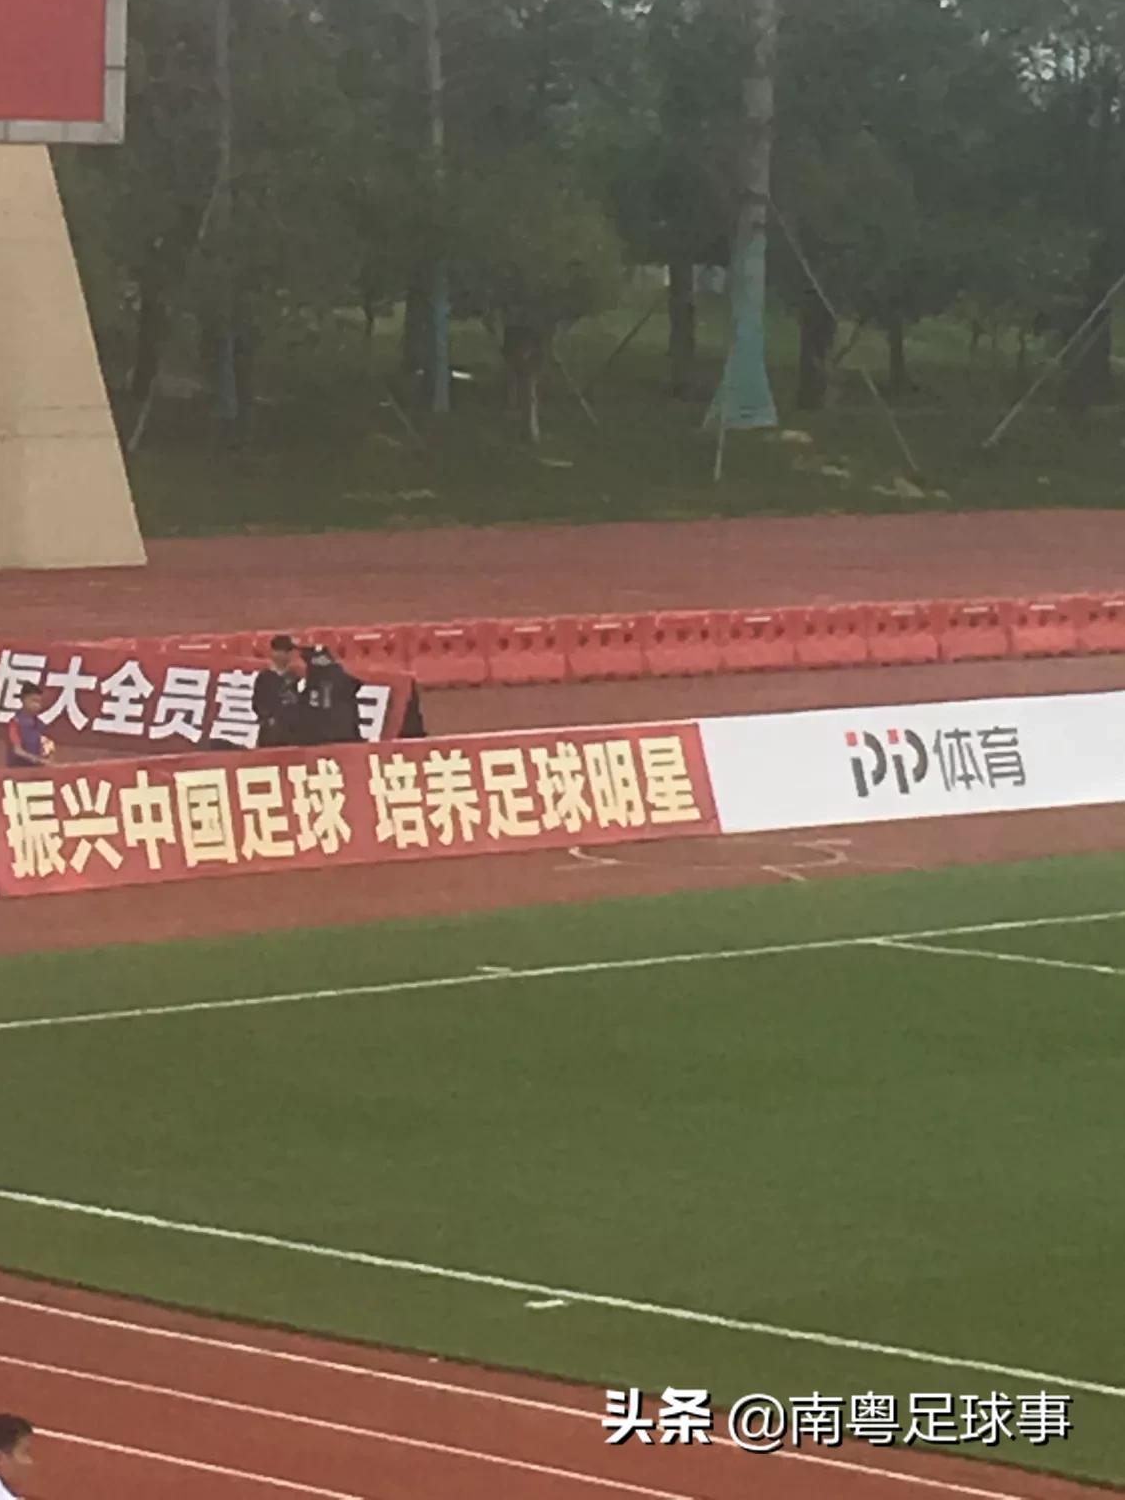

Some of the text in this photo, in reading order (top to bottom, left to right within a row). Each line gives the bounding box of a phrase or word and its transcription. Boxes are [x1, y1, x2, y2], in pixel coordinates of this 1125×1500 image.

[2, 735, 702, 879] 振兴中国足球 培养足球明星
